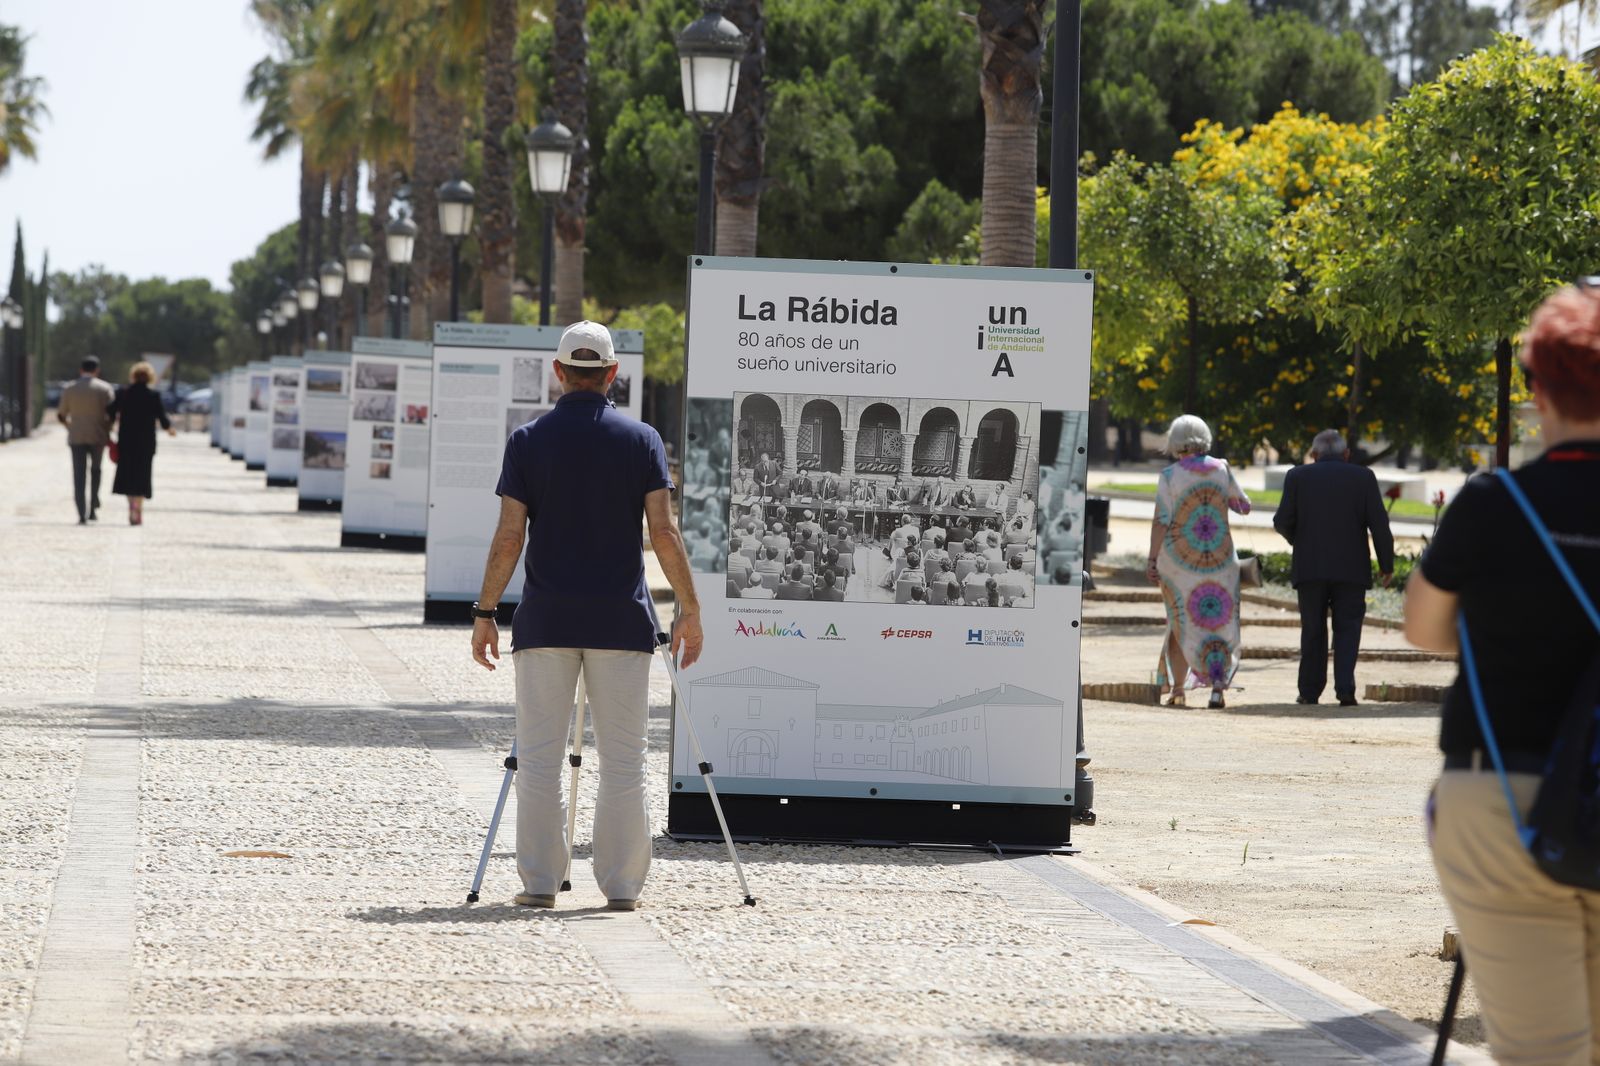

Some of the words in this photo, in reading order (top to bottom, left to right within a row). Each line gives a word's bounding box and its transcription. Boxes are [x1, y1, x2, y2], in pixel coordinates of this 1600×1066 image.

[738, 294, 776, 321] La
[787, 296, 898, 326] Rábida
[989, 306, 1027, 325] un
[988, 326, 1040, 335] Universidad
[988, 335, 1045, 344] Internacional
[738, 331, 759, 347] 80
[764, 333, 805, 349] años
[811, 334, 833, 350] de
[839, 338, 859, 350] un
[987, 343, 999, 351] de
[737, 356, 789, 371] sueño
[795, 357, 897, 375] universitario
[991, 352, 1015, 377] A
[735, 619, 807, 639] Andalucía
[896, 629, 932, 639] CEPSA
